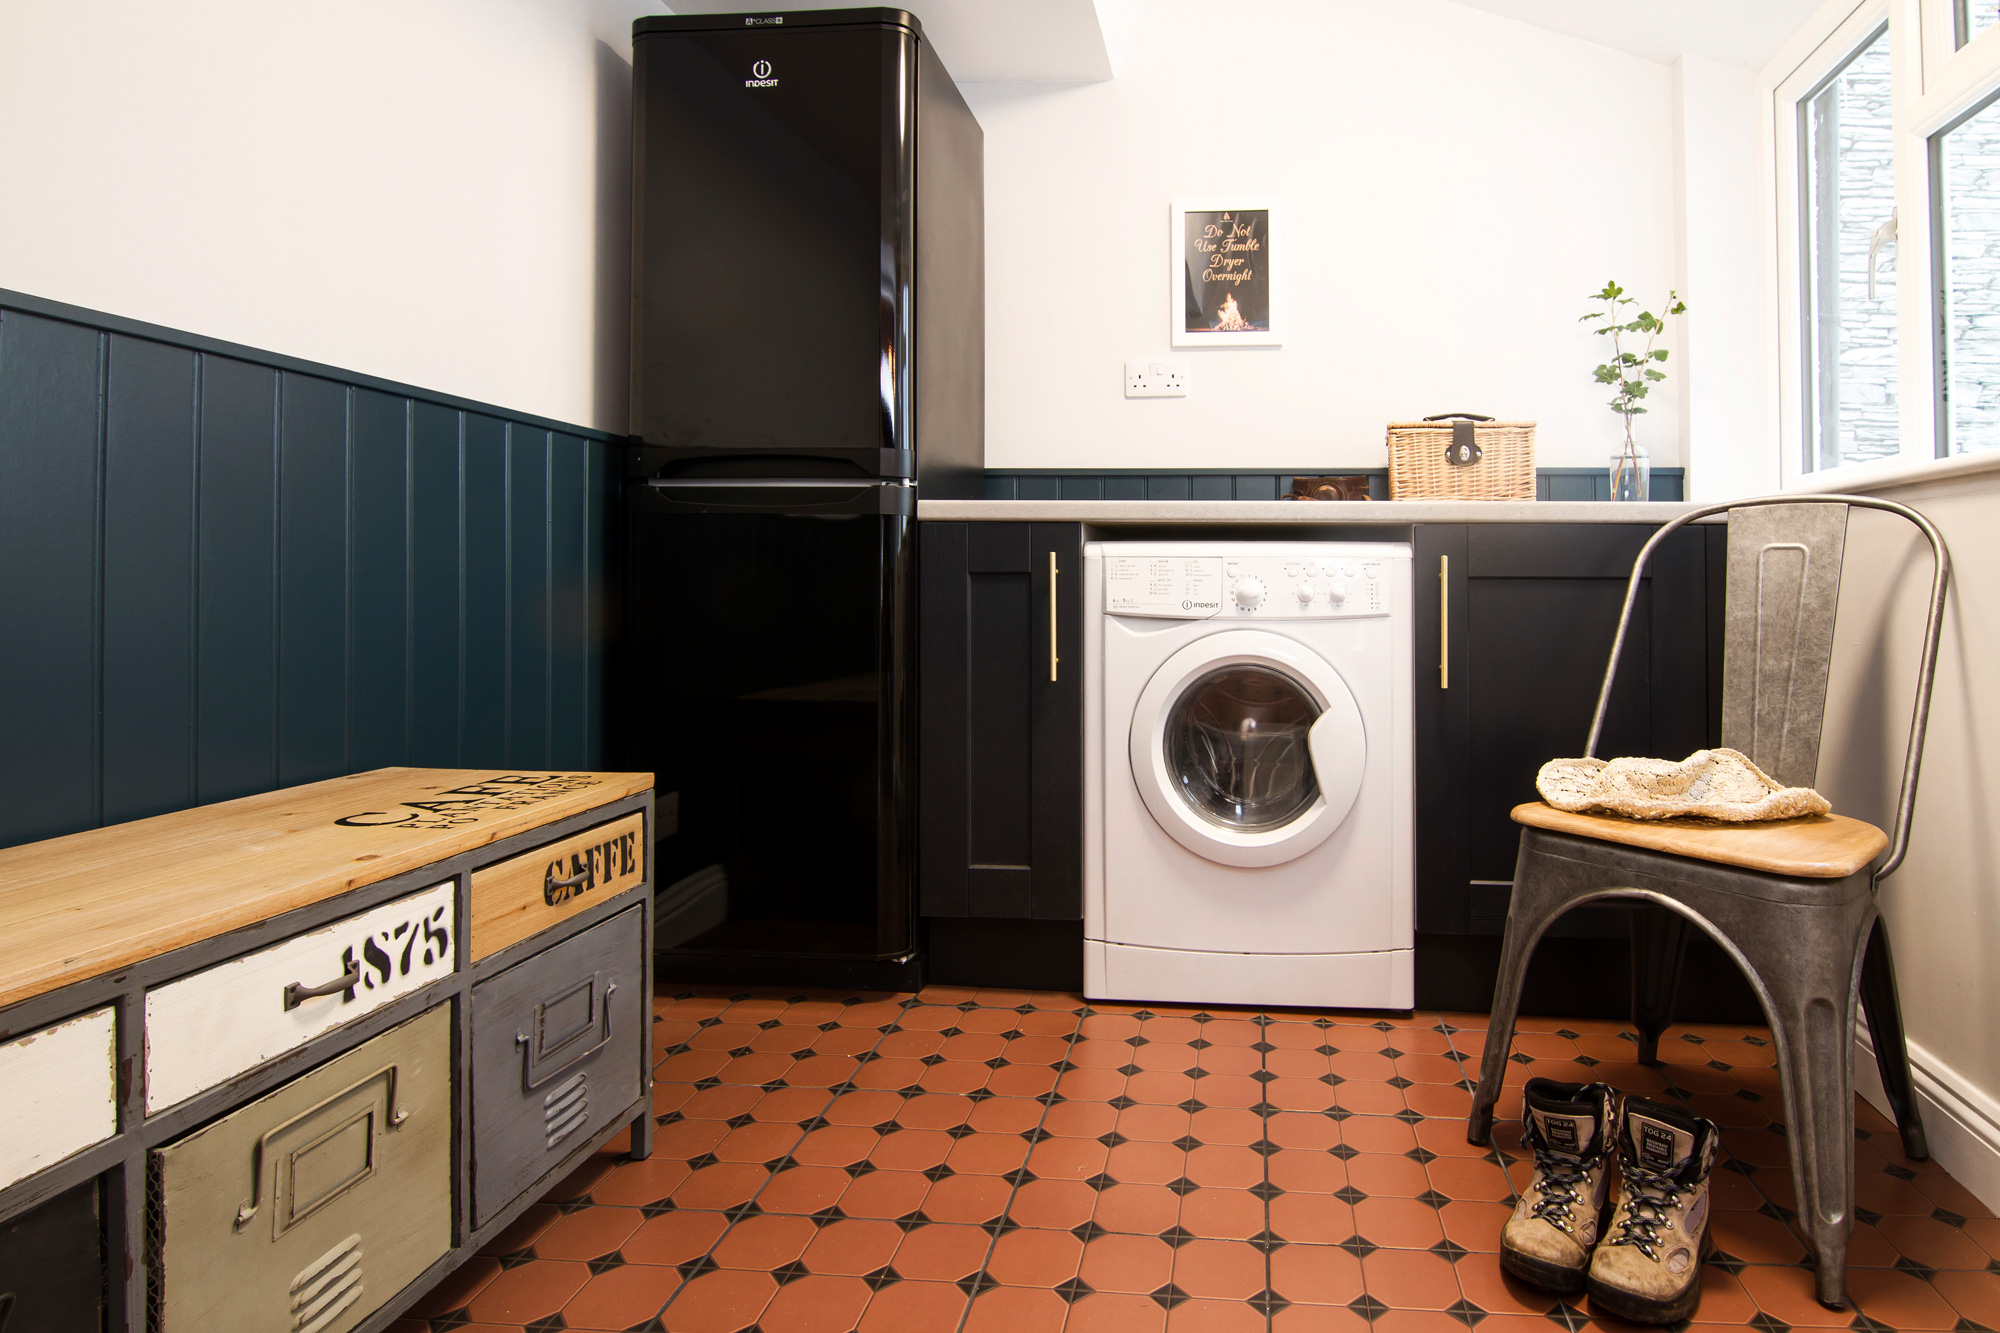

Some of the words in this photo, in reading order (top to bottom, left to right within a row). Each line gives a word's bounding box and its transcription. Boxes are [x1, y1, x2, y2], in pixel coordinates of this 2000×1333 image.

[1203, 224, 1223, 239] Do
[1227, 223, 1251, 238] Not
[1194, 238, 1217, 253] Use
[1220, 238, 1260, 253] Tumble
[1209, 253, 1245, 271] Dryer
[1202, 268, 1253, 286] Overnight
[334, 775, 564, 827] CAFE
[543, 831, 635, 907] CAFFE
[342, 905, 449, 1005] 1875
[1546, 1118, 1562, 1127] TOG
[1643, 1126, 1660, 1137] TOG
[1660, 1132, 1672, 1141] 24
